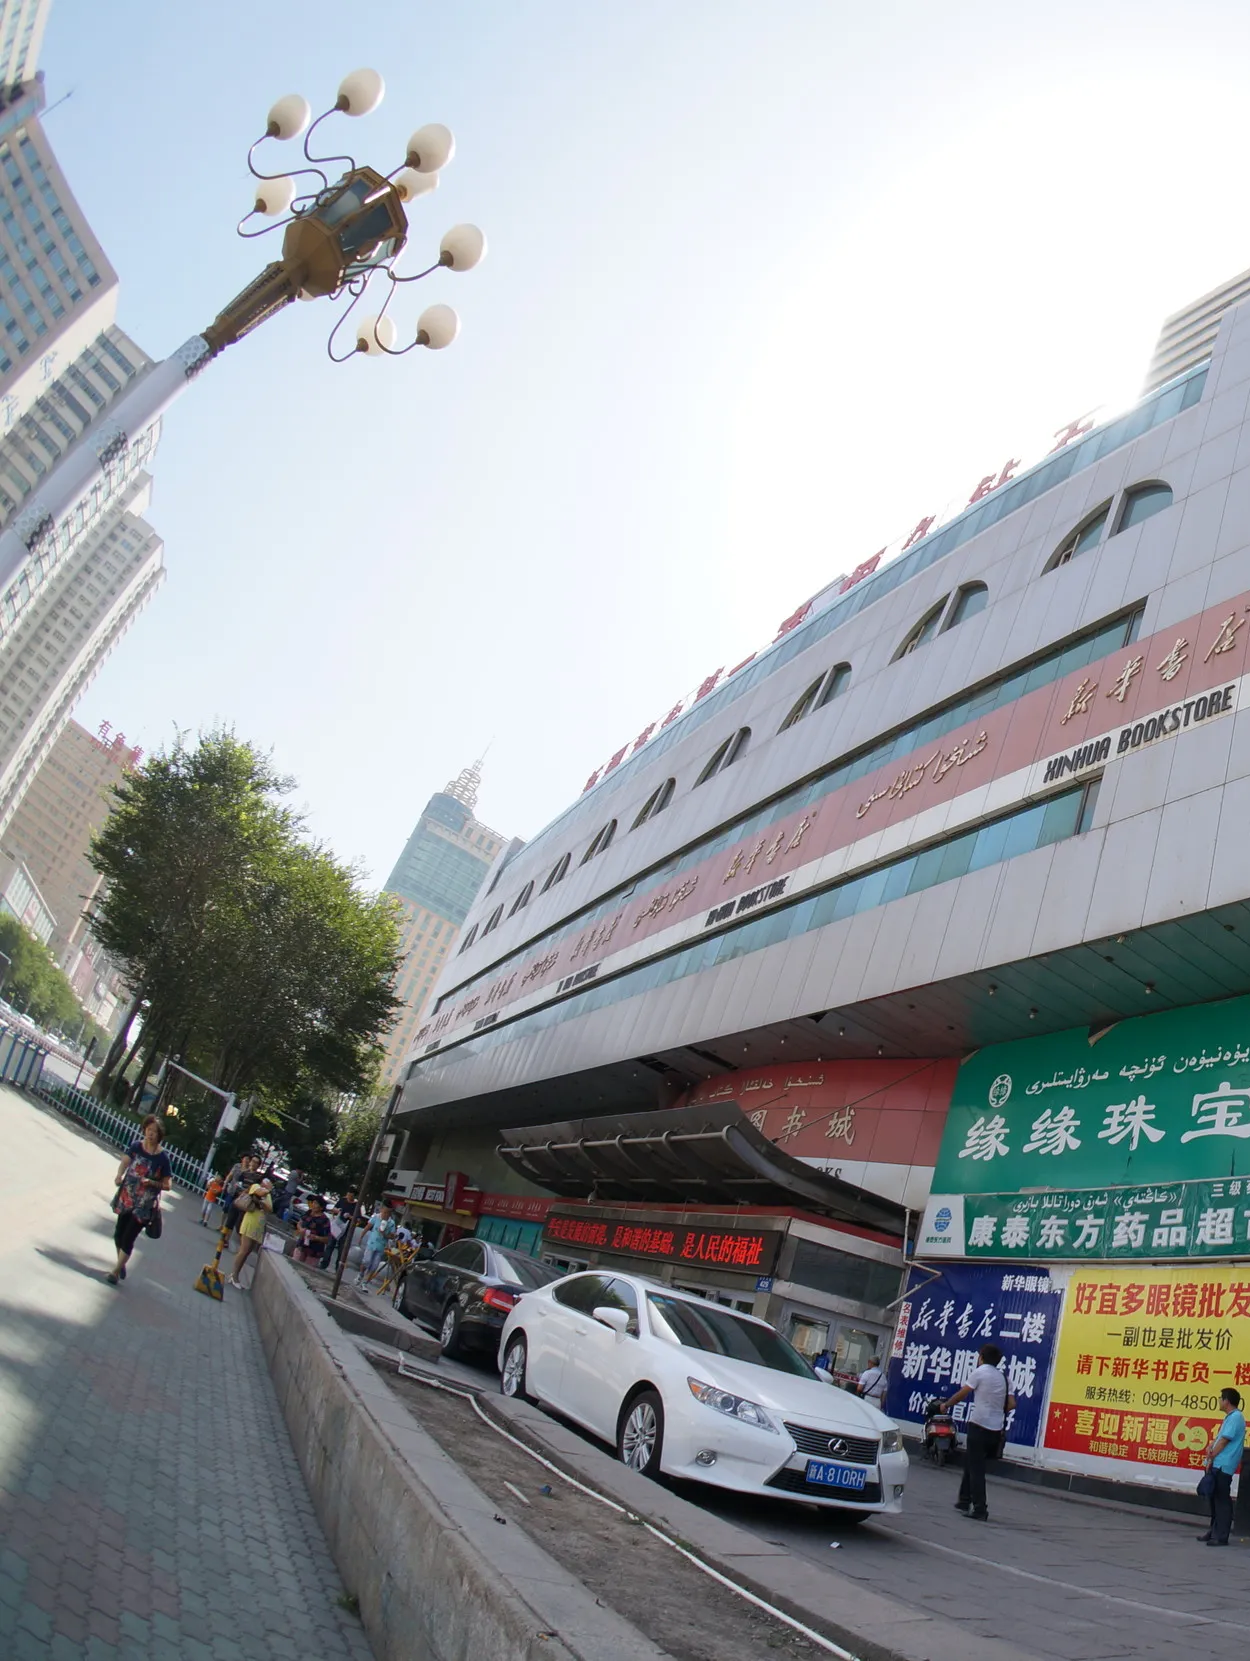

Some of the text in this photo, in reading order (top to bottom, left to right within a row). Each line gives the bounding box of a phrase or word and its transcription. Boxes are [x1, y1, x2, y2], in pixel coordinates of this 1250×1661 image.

[1117, 684, 1236, 752] BOOKSTORE
[1001, 1274, 1062, 1295] 新华眼镜
[999, 1311, 1046, 1344] 二楼
[1107, 1325, 1233, 1351] 一副也是批发价
[901, 1341, 1037, 1398] 新华眼城
[1088, 1440, 1129, 1459] 和谐稳定
[1137, 1447, 1179, 1465] 民族团结
